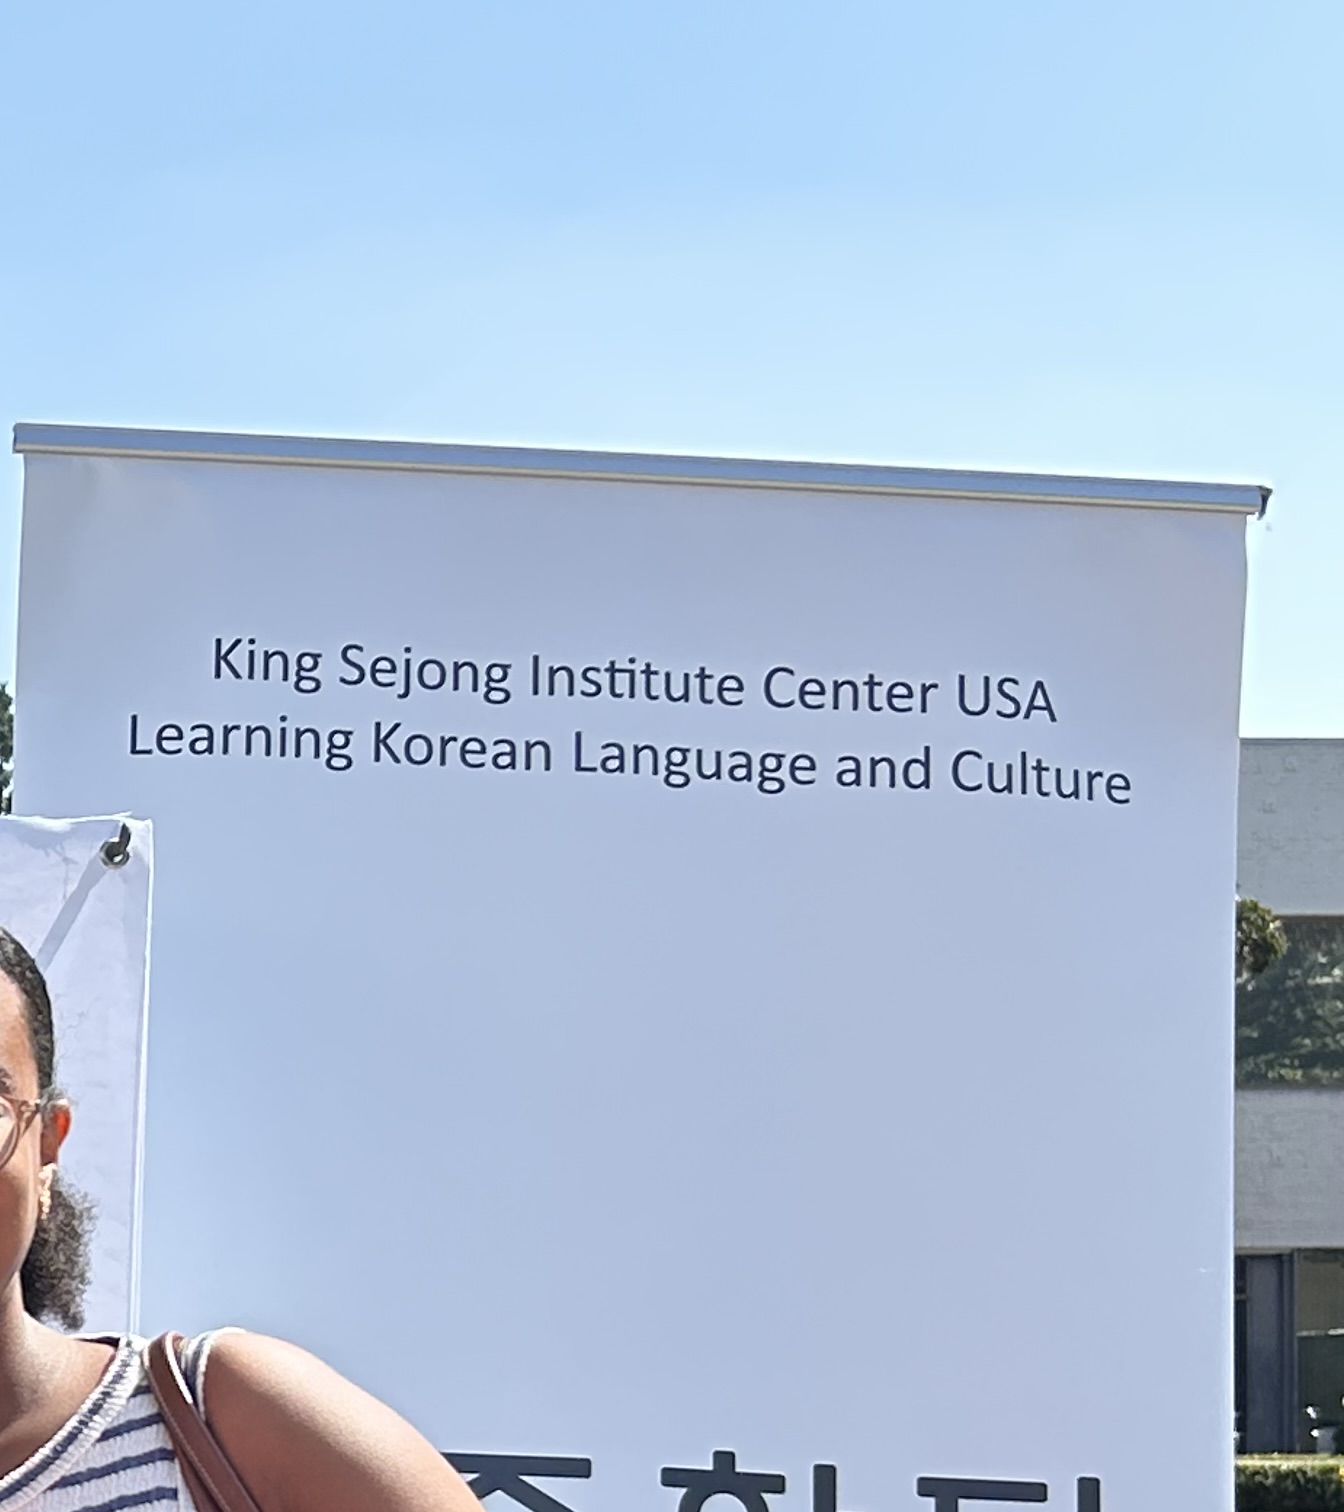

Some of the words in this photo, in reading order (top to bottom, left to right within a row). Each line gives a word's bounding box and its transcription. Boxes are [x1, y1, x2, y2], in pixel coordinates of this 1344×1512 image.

[213, 636, 322, 694] King
[339, 642, 512, 702] Sejong
[532, 653, 745, 706] Institute
[763, 665, 938, 714] Center
[958, 673, 1058, 723] USA
[129, 713, 354, 772] Learning
[373, 720, 551, 773] Korean
[574, 729, 817, 792] Language
[836, 745, 931, 791] and
[951, 749, 1132, 806] Culture
